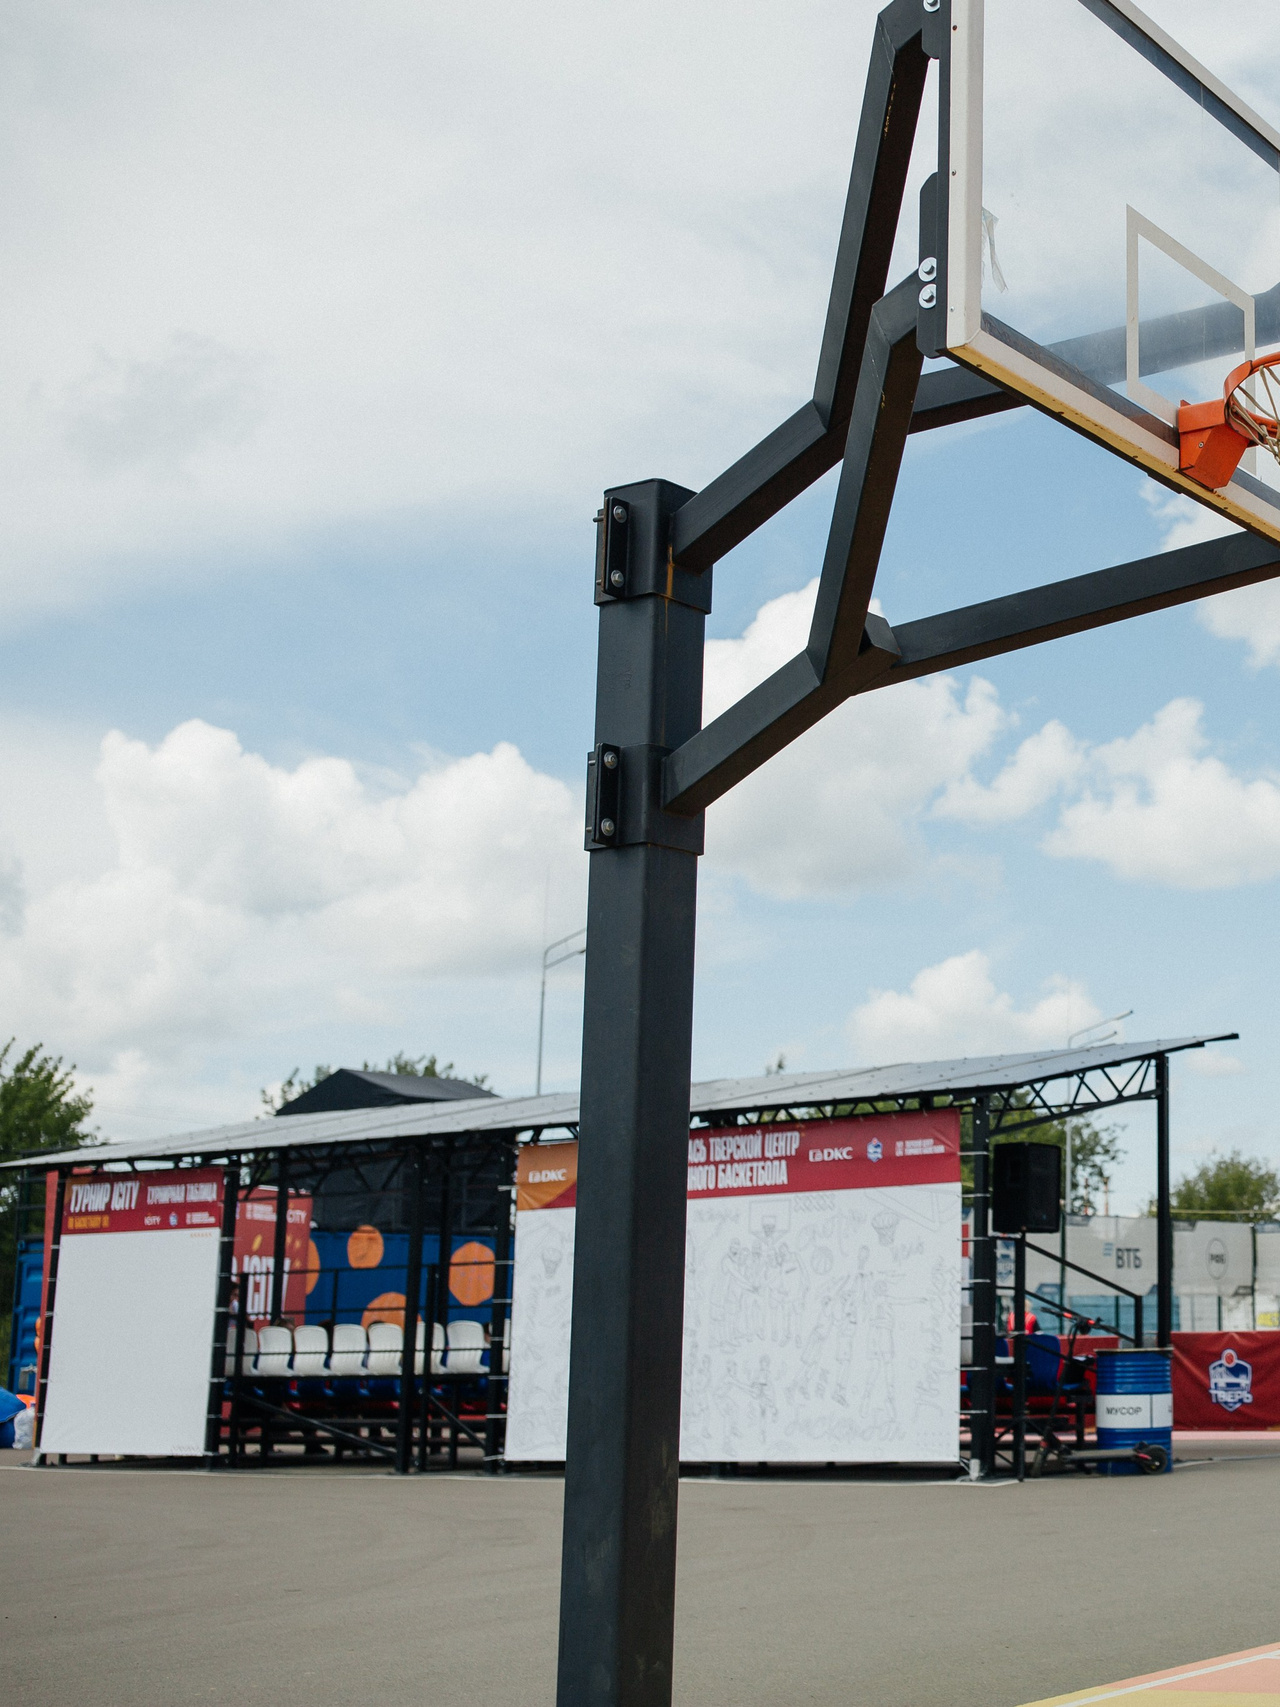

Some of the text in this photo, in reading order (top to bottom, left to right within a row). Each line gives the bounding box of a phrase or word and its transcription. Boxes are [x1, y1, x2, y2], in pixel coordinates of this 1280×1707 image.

[709, 1129, 763, 1162] ТВЕРСКОЙ
[764, 1131, 800, 1159] ЦЕНТР
[823, 1147, 853, 1161] DKC
[541, 1168, 567, 1183] DKC
[717, 1160, 788, 1189] БАСКЕТБОЛА
[69, 1180, 140, 1213] ТУРНИР ICITY
[1116, 1247, 1142, 1269] ВТБ
[1208, 1389, 1253, 1403] ТВЕРЬ
[1106, 1406, 1143, 1416] МУСОР
